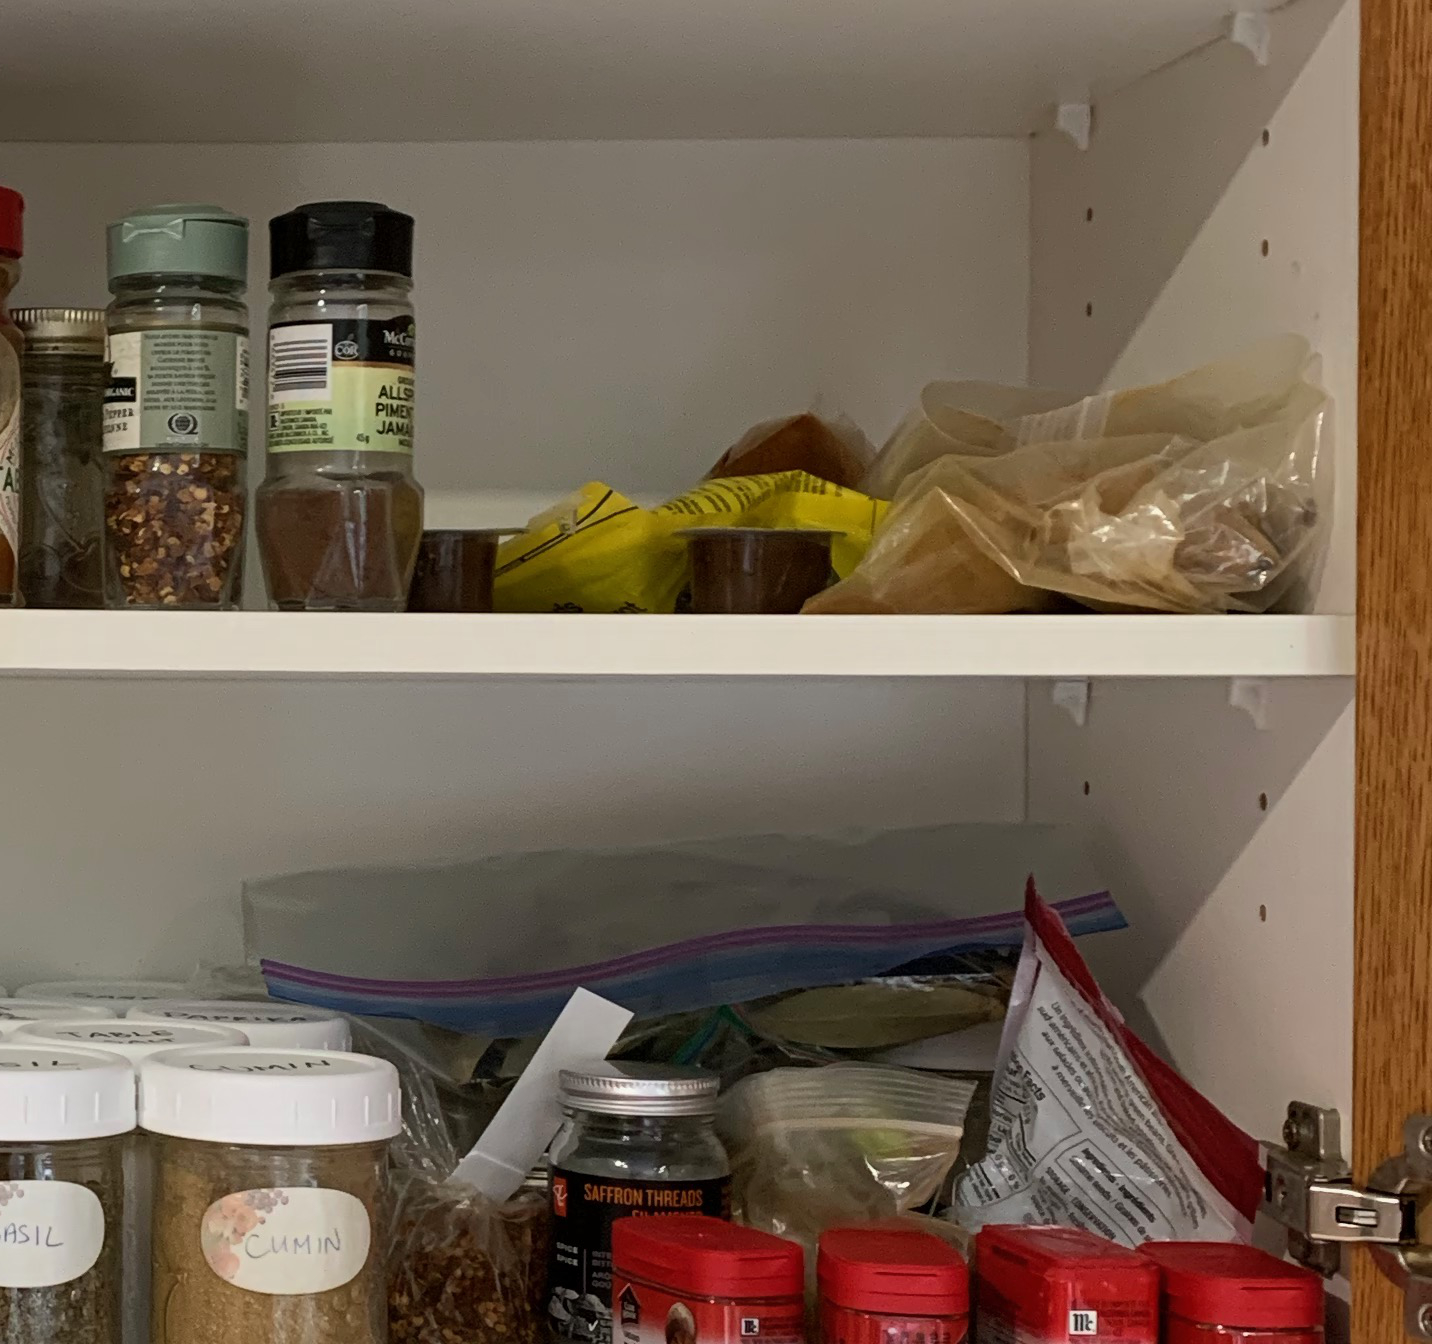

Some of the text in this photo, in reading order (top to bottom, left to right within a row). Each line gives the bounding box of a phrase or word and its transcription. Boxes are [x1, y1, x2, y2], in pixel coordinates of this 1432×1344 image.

[188, 1059, 332, 1072] CUMIN
[584, 1183, 703, 1207] SAFFRON THREADS
[245, 1228, 341, 1258] CUMIN
